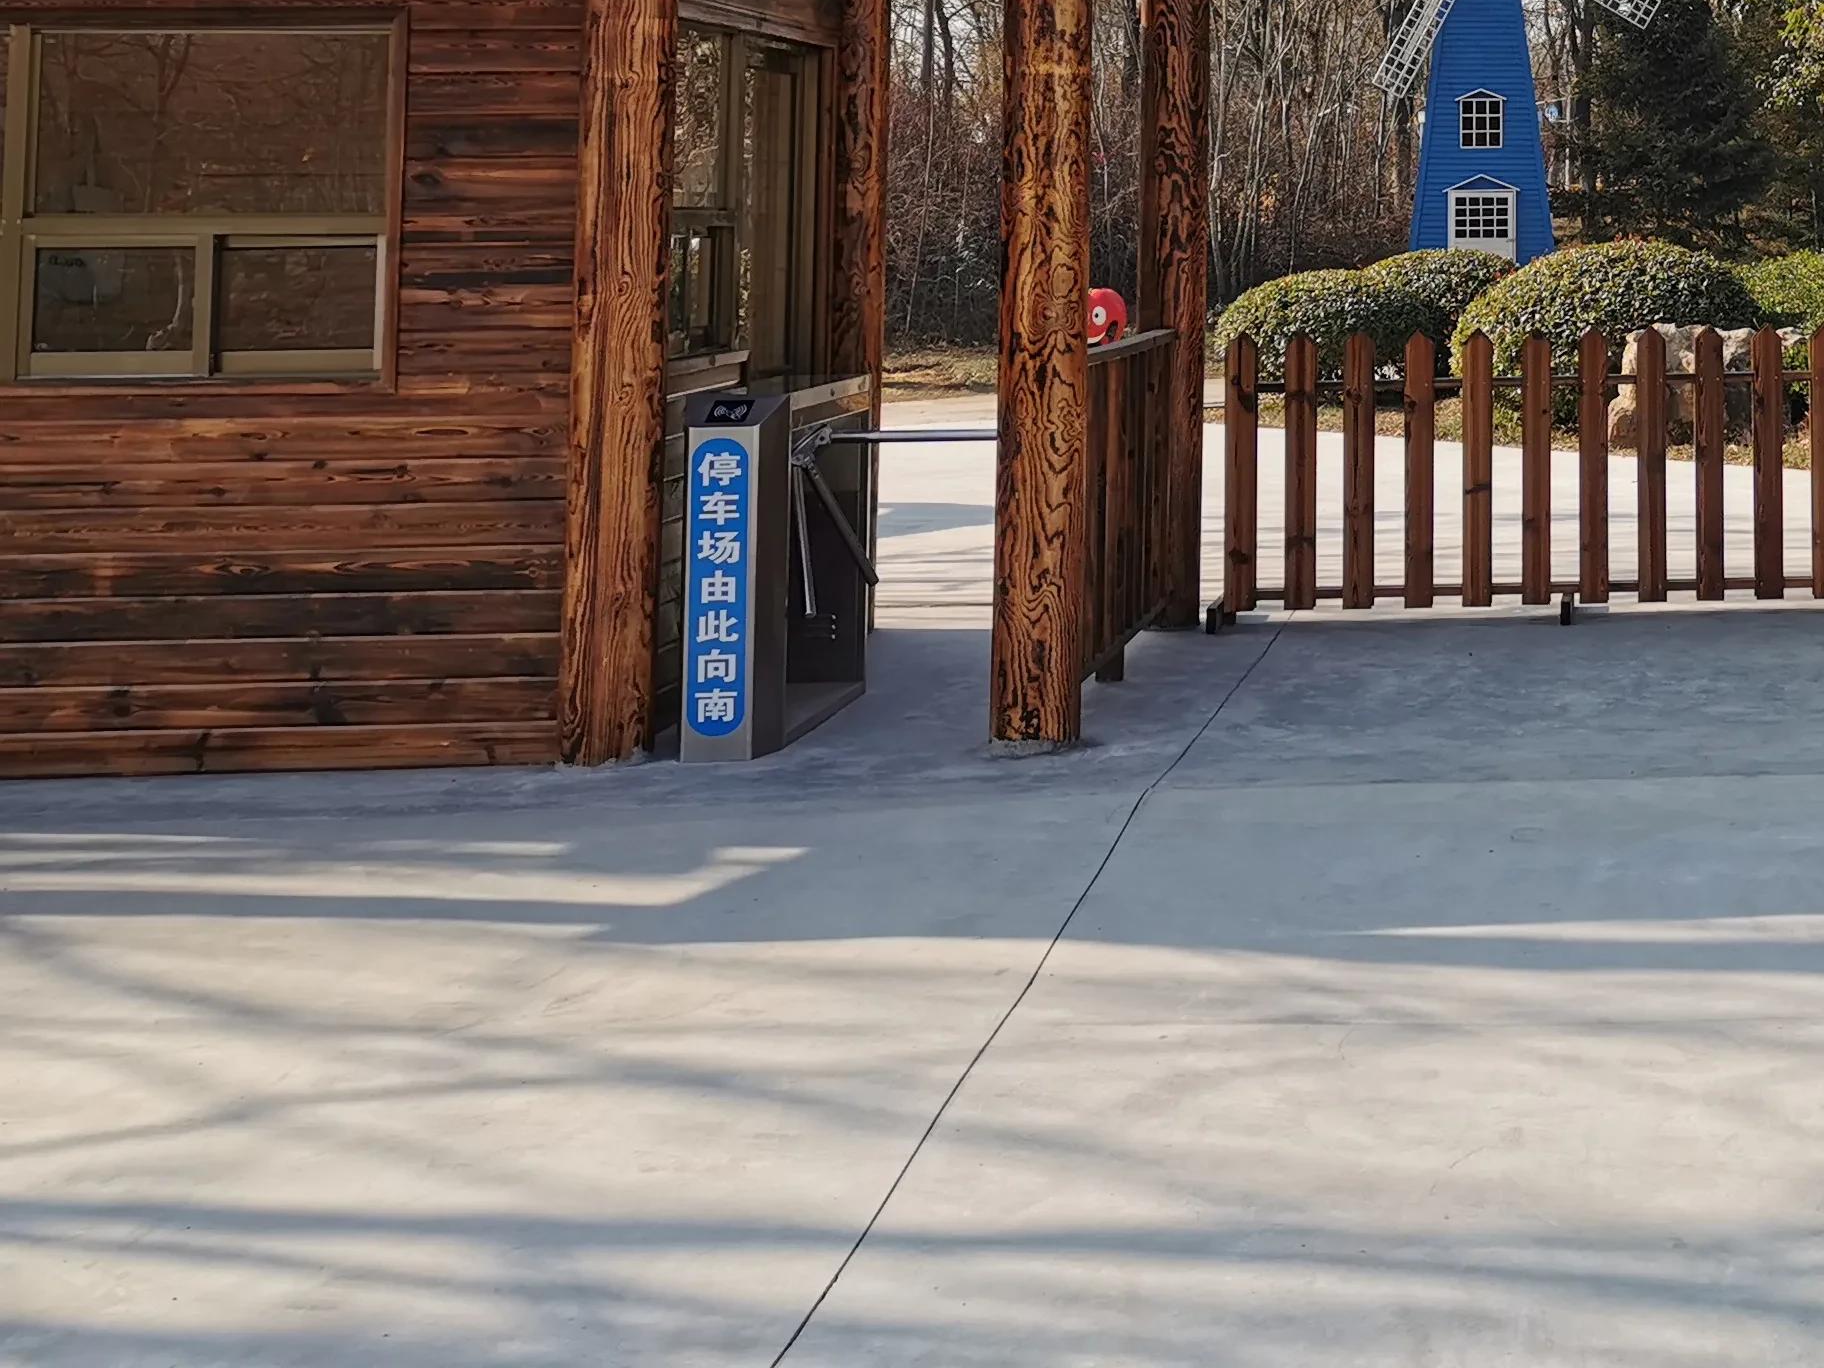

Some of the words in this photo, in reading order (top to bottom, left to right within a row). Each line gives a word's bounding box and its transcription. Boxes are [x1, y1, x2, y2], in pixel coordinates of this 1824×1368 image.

[694, 452, 742, 724] 停车场由此向南
